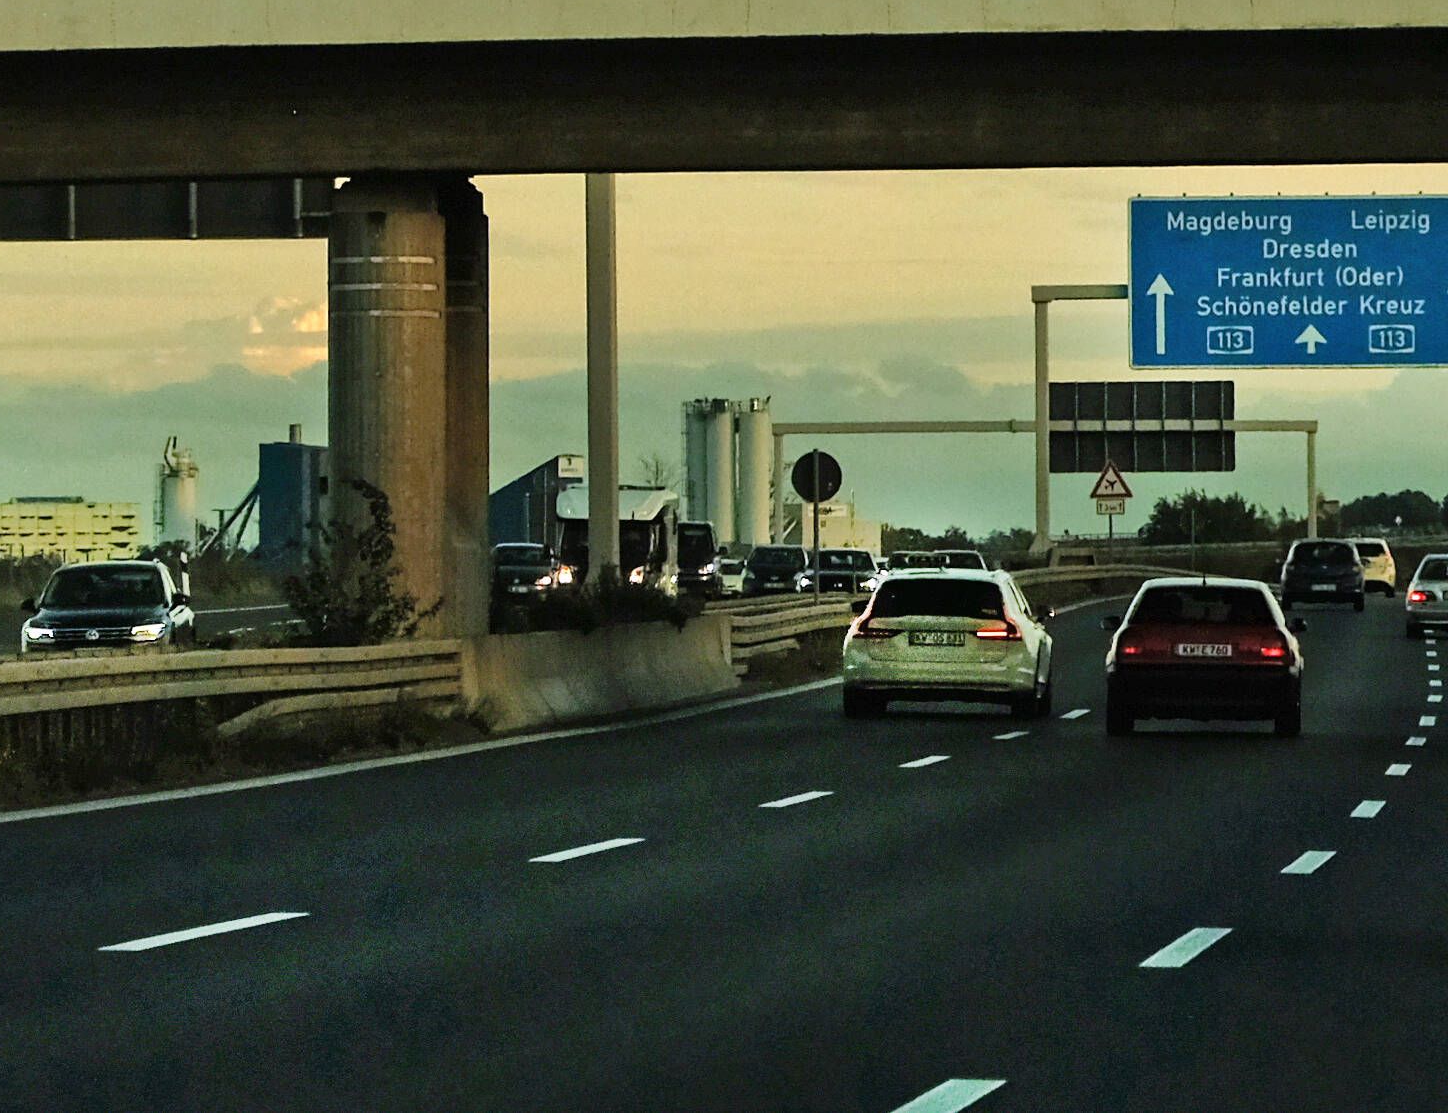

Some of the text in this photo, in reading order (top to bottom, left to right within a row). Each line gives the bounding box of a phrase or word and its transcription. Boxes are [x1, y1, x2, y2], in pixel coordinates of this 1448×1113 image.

[1166, 210, 1431, 235] Magdeburg Leipzig
[1262, 238, 1358, 259] Dresden
[1217, 265, 1404, 288] Frankfurt (Oder)
[1196, 294, 1426, 317] Schönefelder Kreuz
[1217, 332, 1245, 349] 113
[1379, 331, 1406, 348] 113
